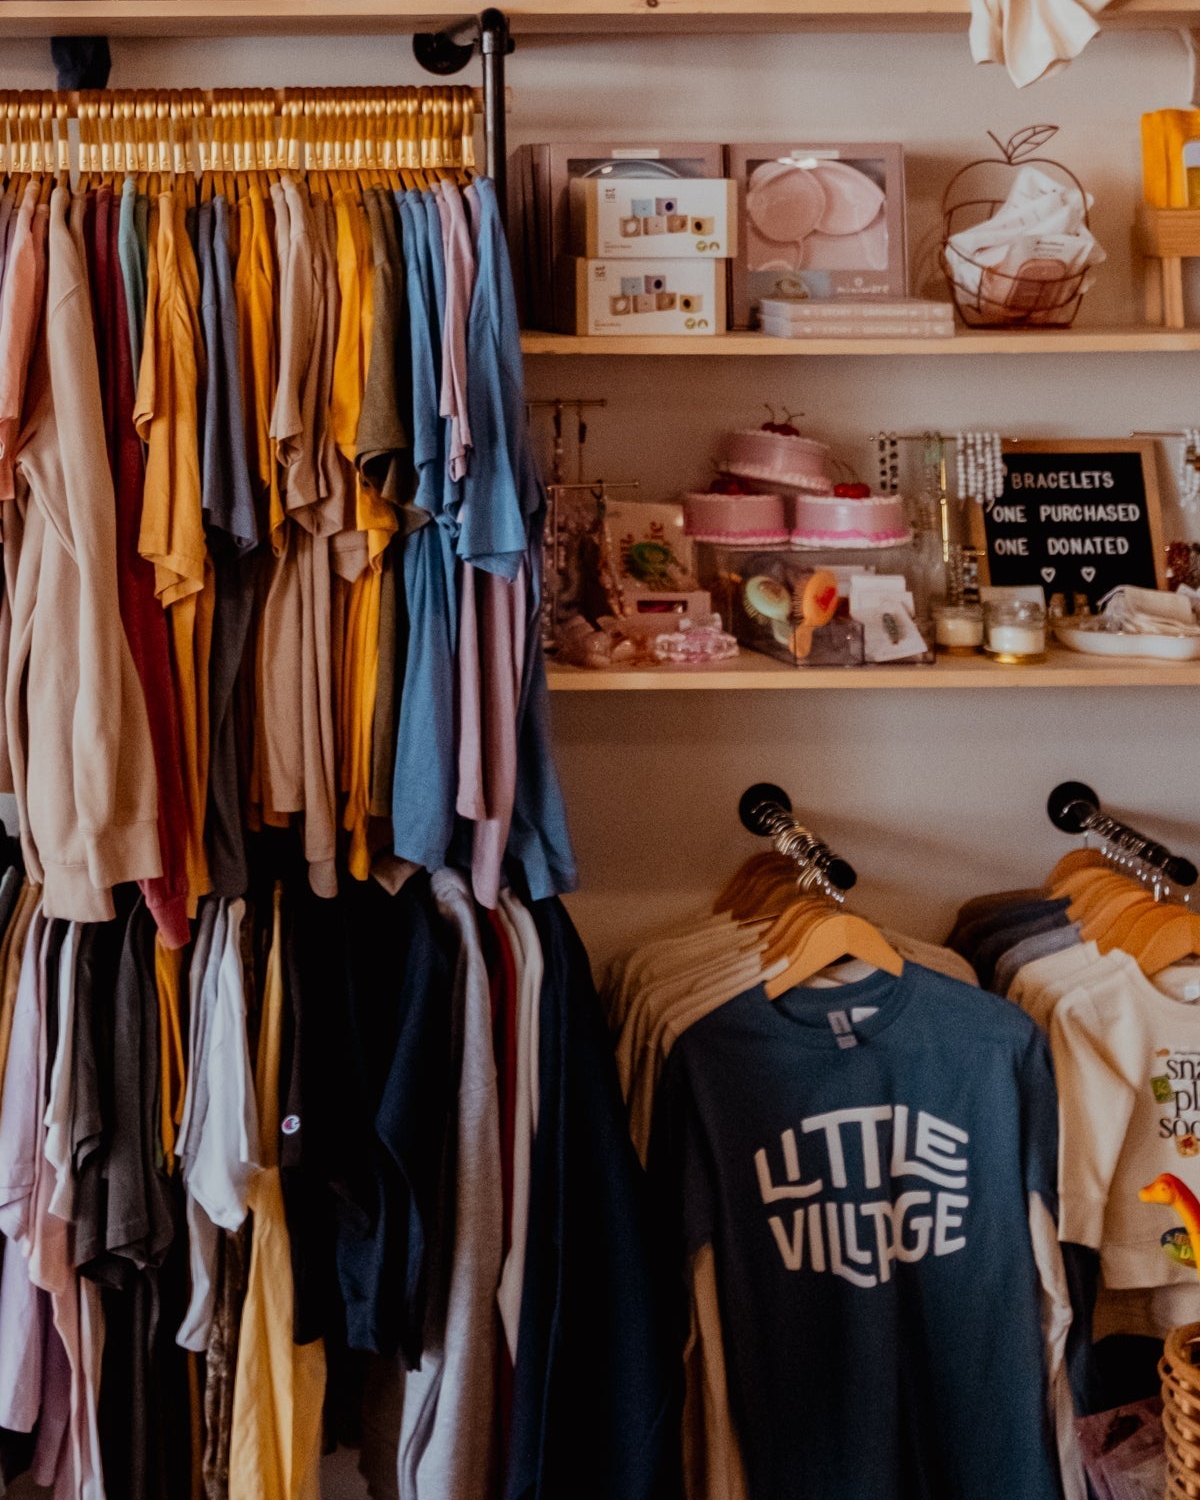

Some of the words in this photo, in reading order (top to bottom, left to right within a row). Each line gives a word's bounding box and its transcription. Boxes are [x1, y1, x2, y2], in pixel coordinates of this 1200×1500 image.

[1011, 471, 1114, 489] BRACELETS
[992, 504, 1027, 523] ONE
[1040, 503, 1140, 523] PURCHASED
[994, 537, 1029, 556] ONE
[1047, 536, 1129, 555] DONATED
[754, 1104, 969, 1204] LITTLE
[768, 1191, 969, 1288] VILLAGE
